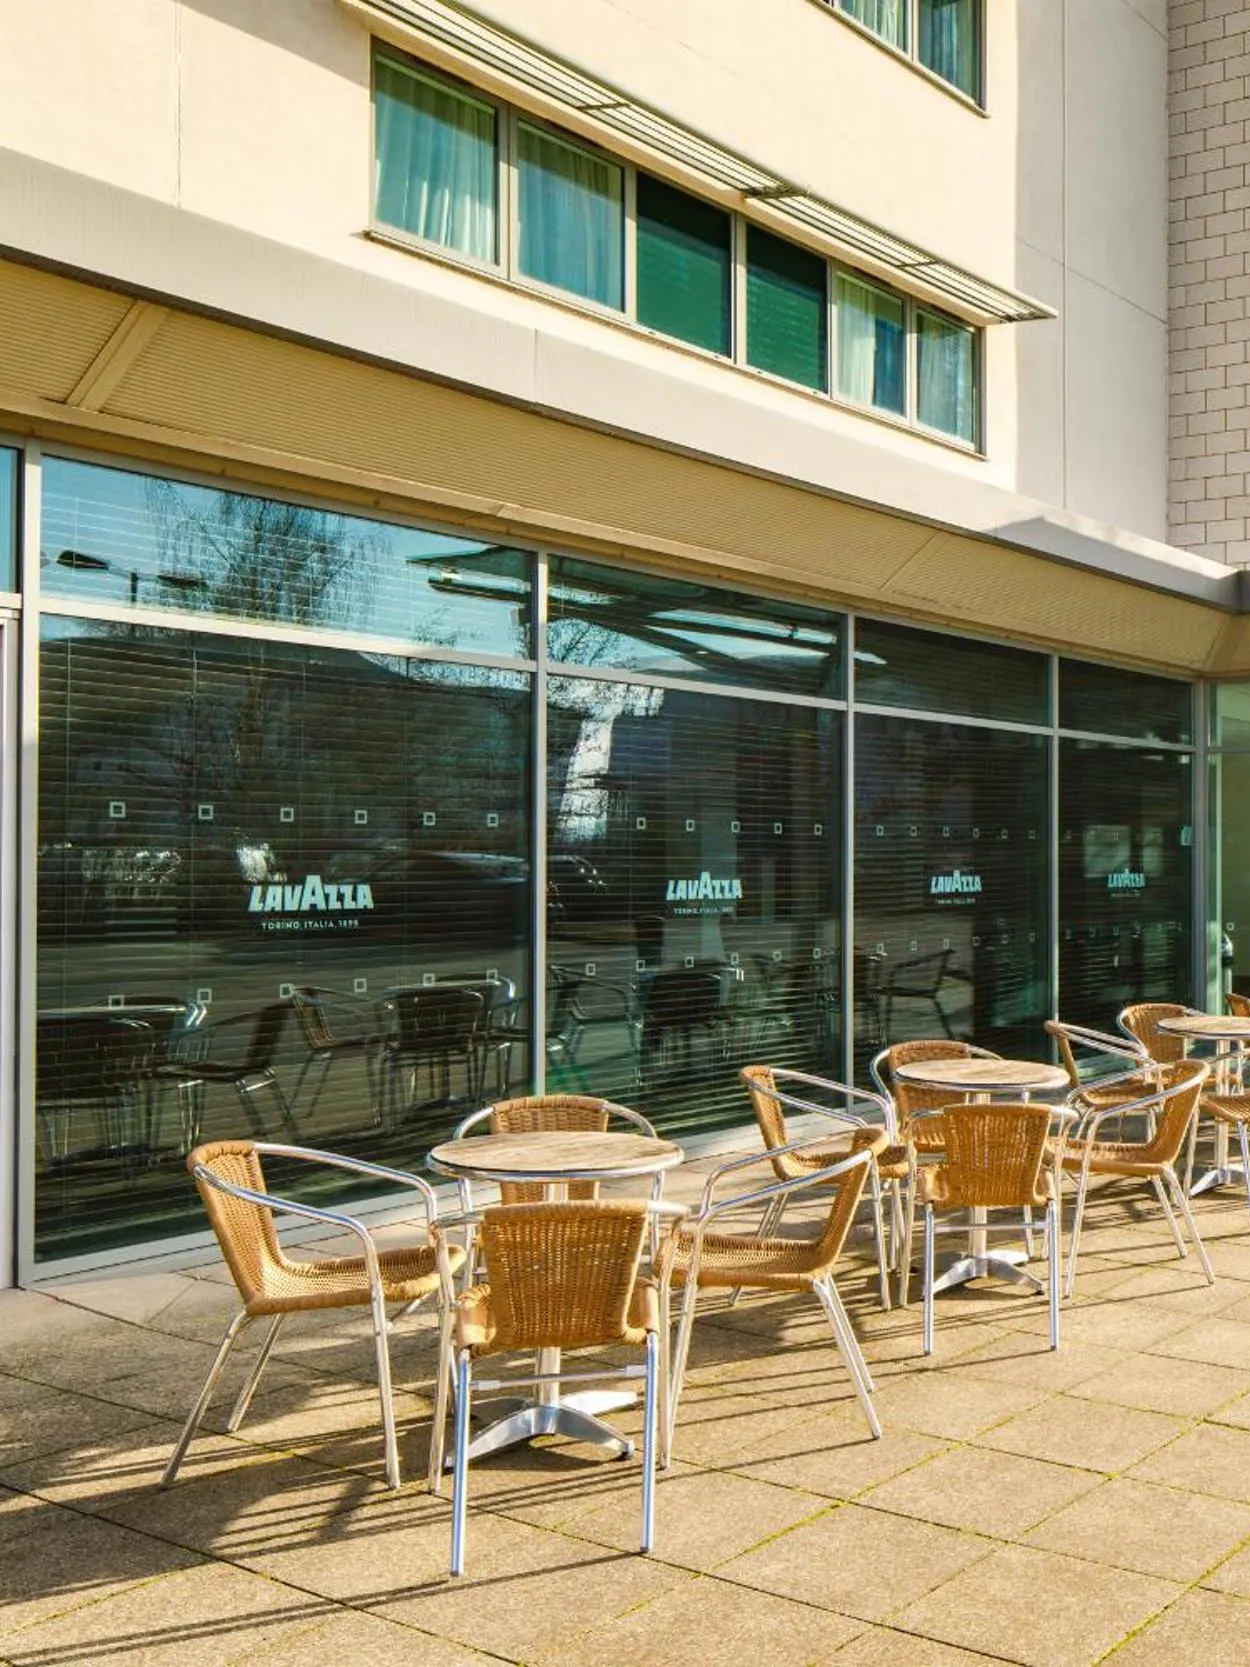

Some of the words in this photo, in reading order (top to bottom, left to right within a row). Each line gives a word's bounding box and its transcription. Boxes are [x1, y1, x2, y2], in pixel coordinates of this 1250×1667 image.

[248, 874, 375, 912] LAVAZZA
[666, 871, 743, 901] LAVAZZA
[930, 870, 983, 894] LAVAZZA
